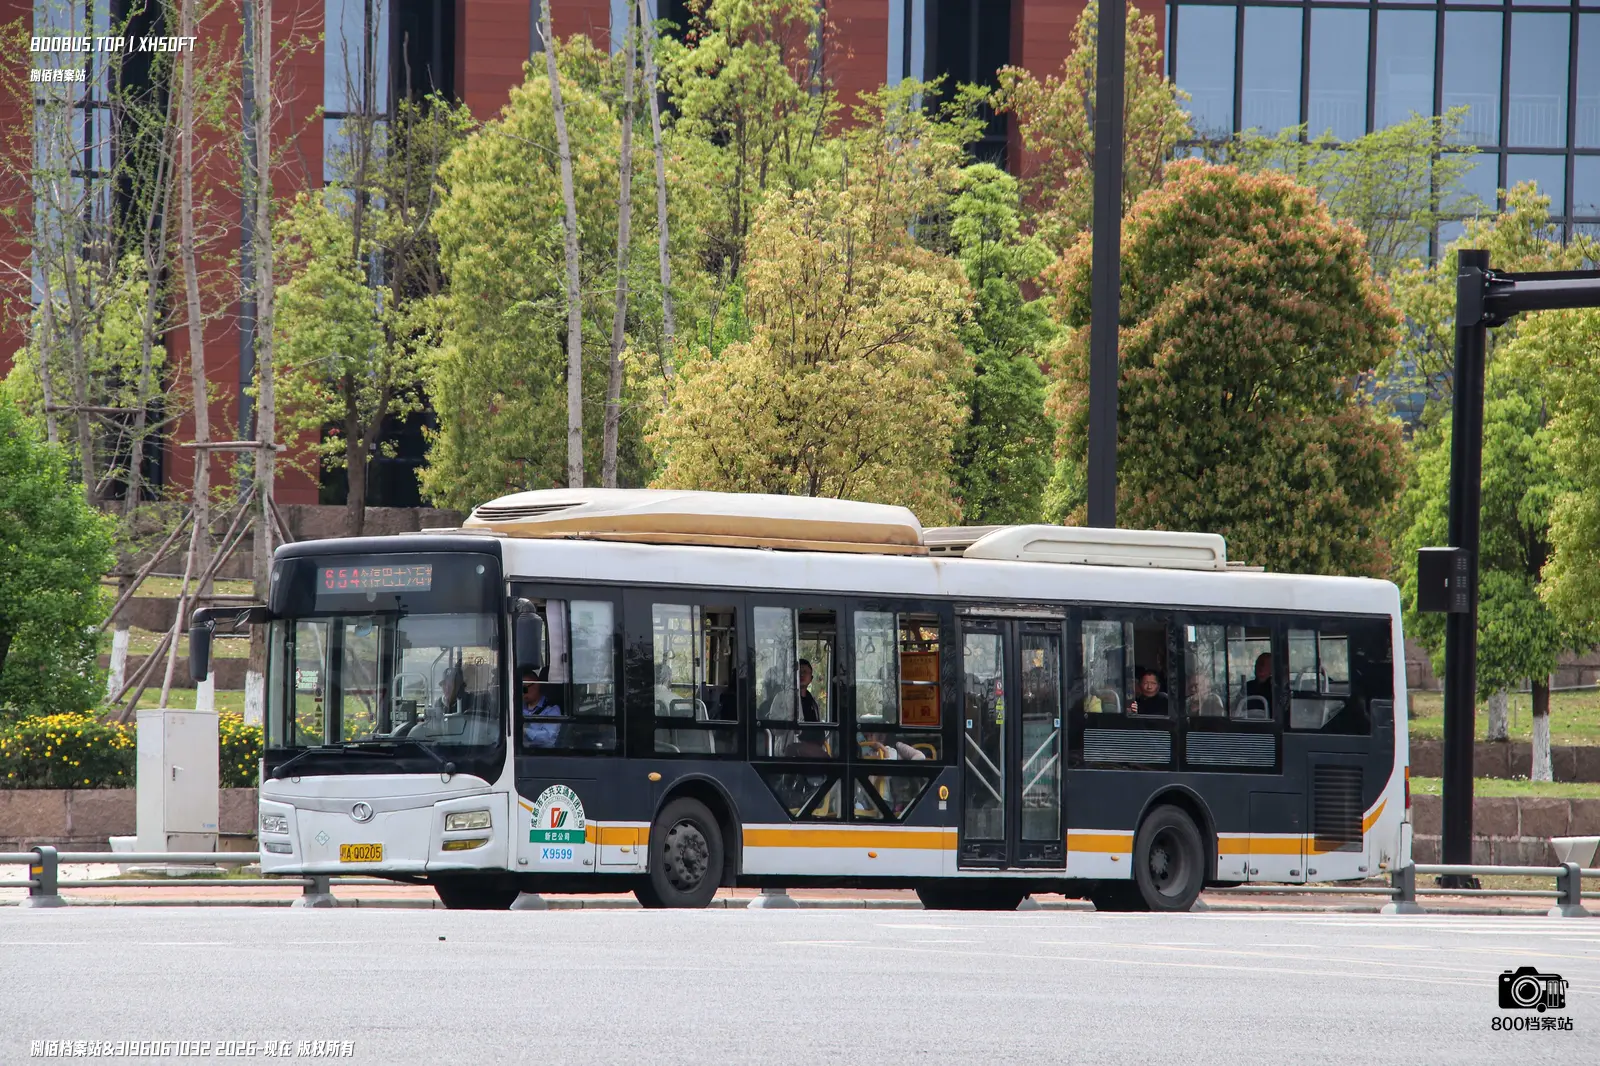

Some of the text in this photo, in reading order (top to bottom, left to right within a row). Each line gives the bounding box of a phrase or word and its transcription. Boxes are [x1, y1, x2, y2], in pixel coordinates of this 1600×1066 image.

[544, 832, 570, 842] 新巴公司
[542, 848, 572, 860] X9599
